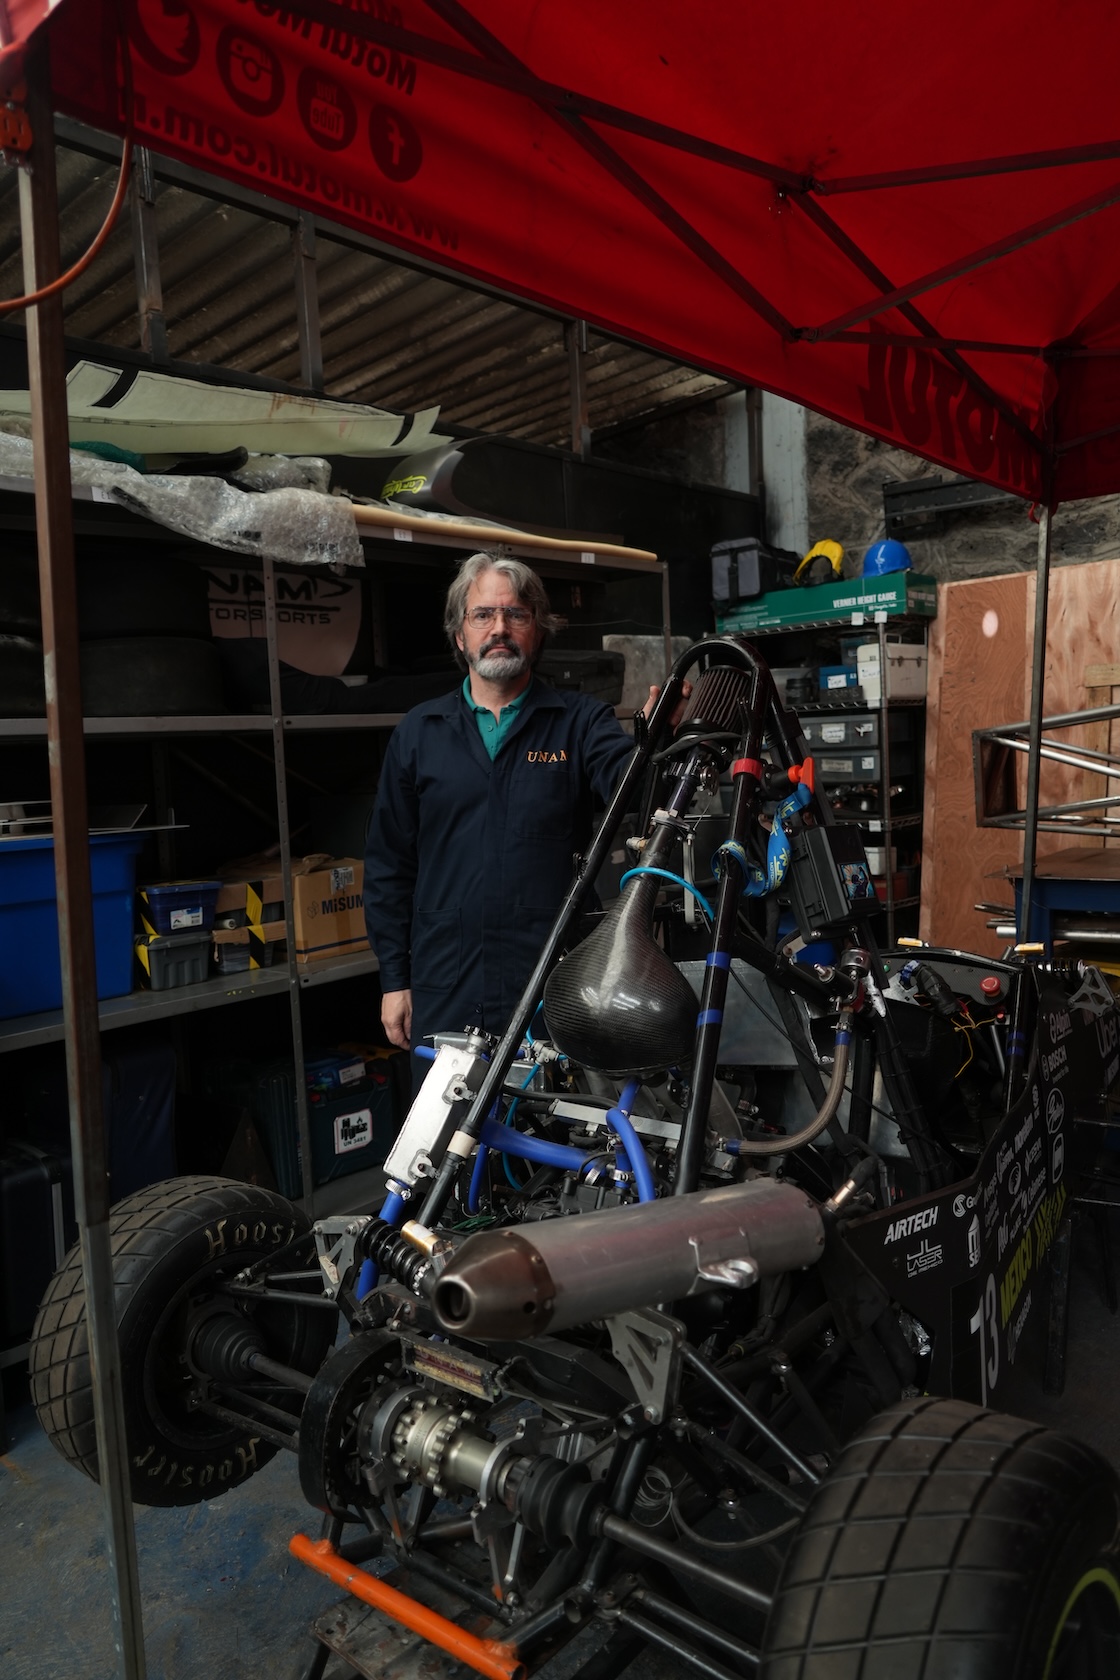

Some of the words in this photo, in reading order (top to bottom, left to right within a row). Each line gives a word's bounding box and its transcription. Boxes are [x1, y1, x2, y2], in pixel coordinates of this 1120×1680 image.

[203, 570, 314, 601] NAM
[209, 607, 331, 625] ORSORTS
[1048, 1044, 1068, 1072] BOSCH
[884, 1206, 939, 1246] AIRTECH
[907, 1248, 943, 1273] LASER
[1000, 1227, 1033, 1331] MEXICO
[969, 1272, 999, 1409] 13
